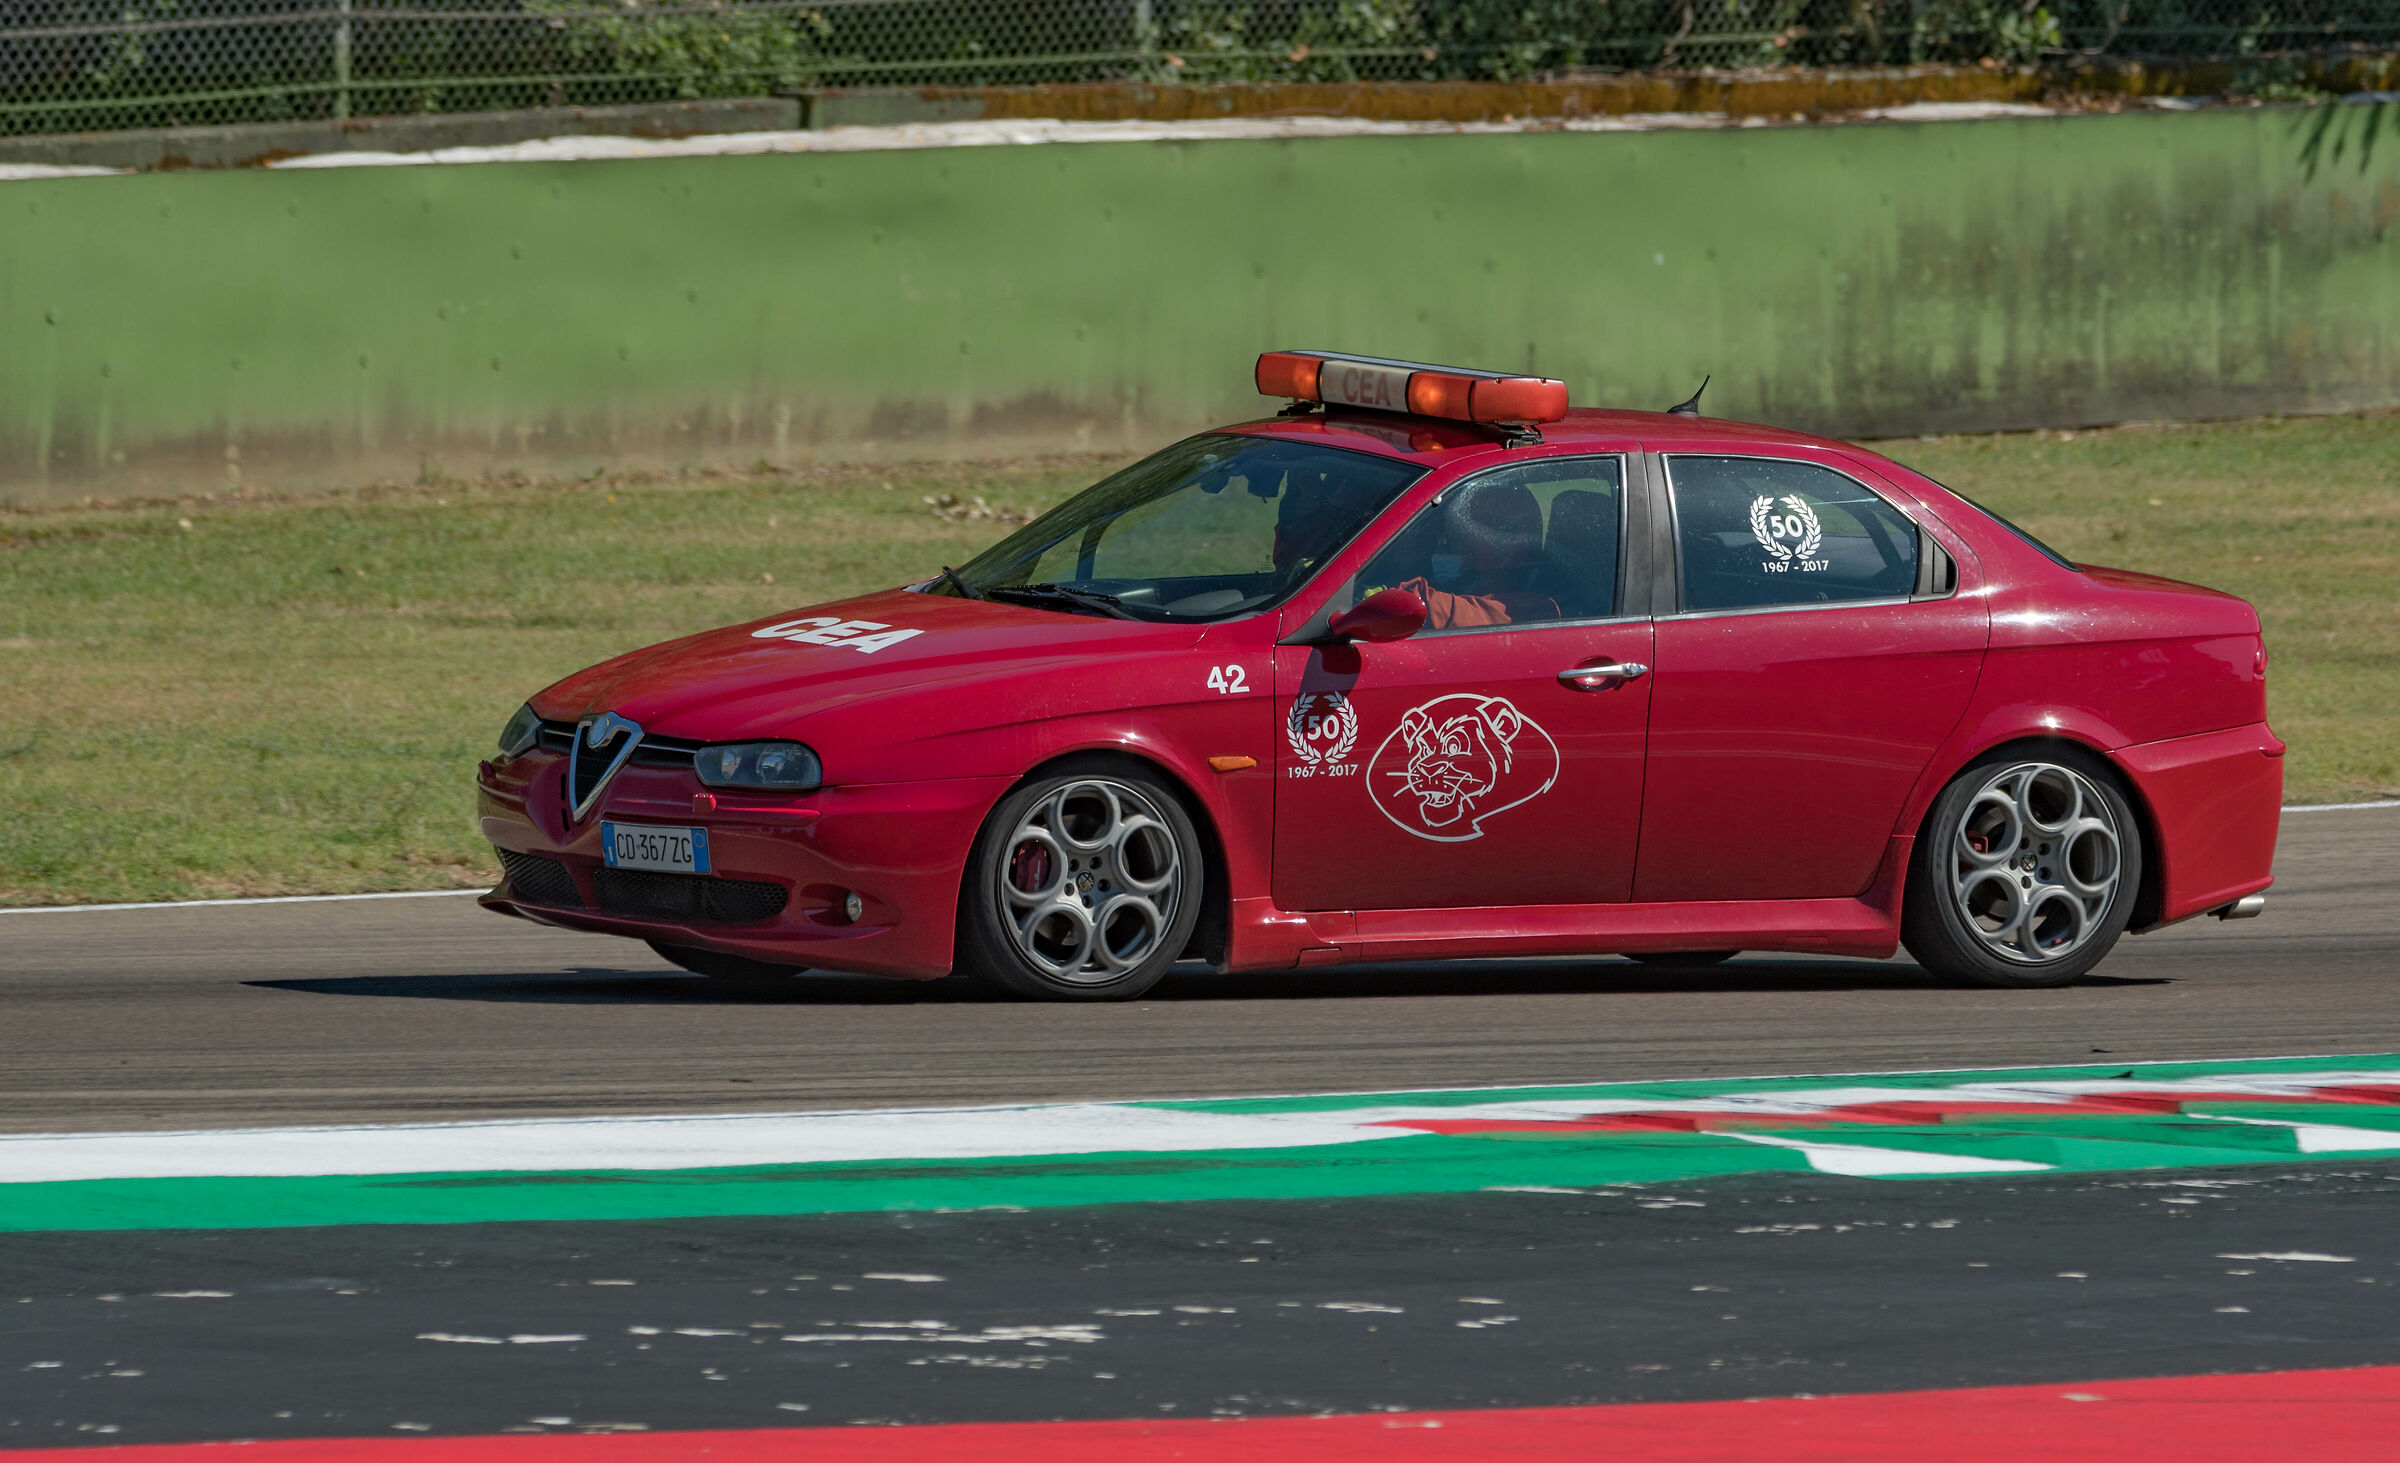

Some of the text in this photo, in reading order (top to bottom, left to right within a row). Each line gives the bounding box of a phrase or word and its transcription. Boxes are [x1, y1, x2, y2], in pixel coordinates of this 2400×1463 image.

[1343, 367, 1392, 406] CEA
[1770, 514, 1804, 538] 50
[1762, 561, 1790, 573] 1967
[1801, 560, 1829, 572] 2017
[751, 616, 926, 654] CEA
[1206, 664, 1250, 694] 42
[1307, 714, 1340, 741] 50
[1288, 766, 1317, 779] 1967
[1328, 764, 1359, 777] 2017
